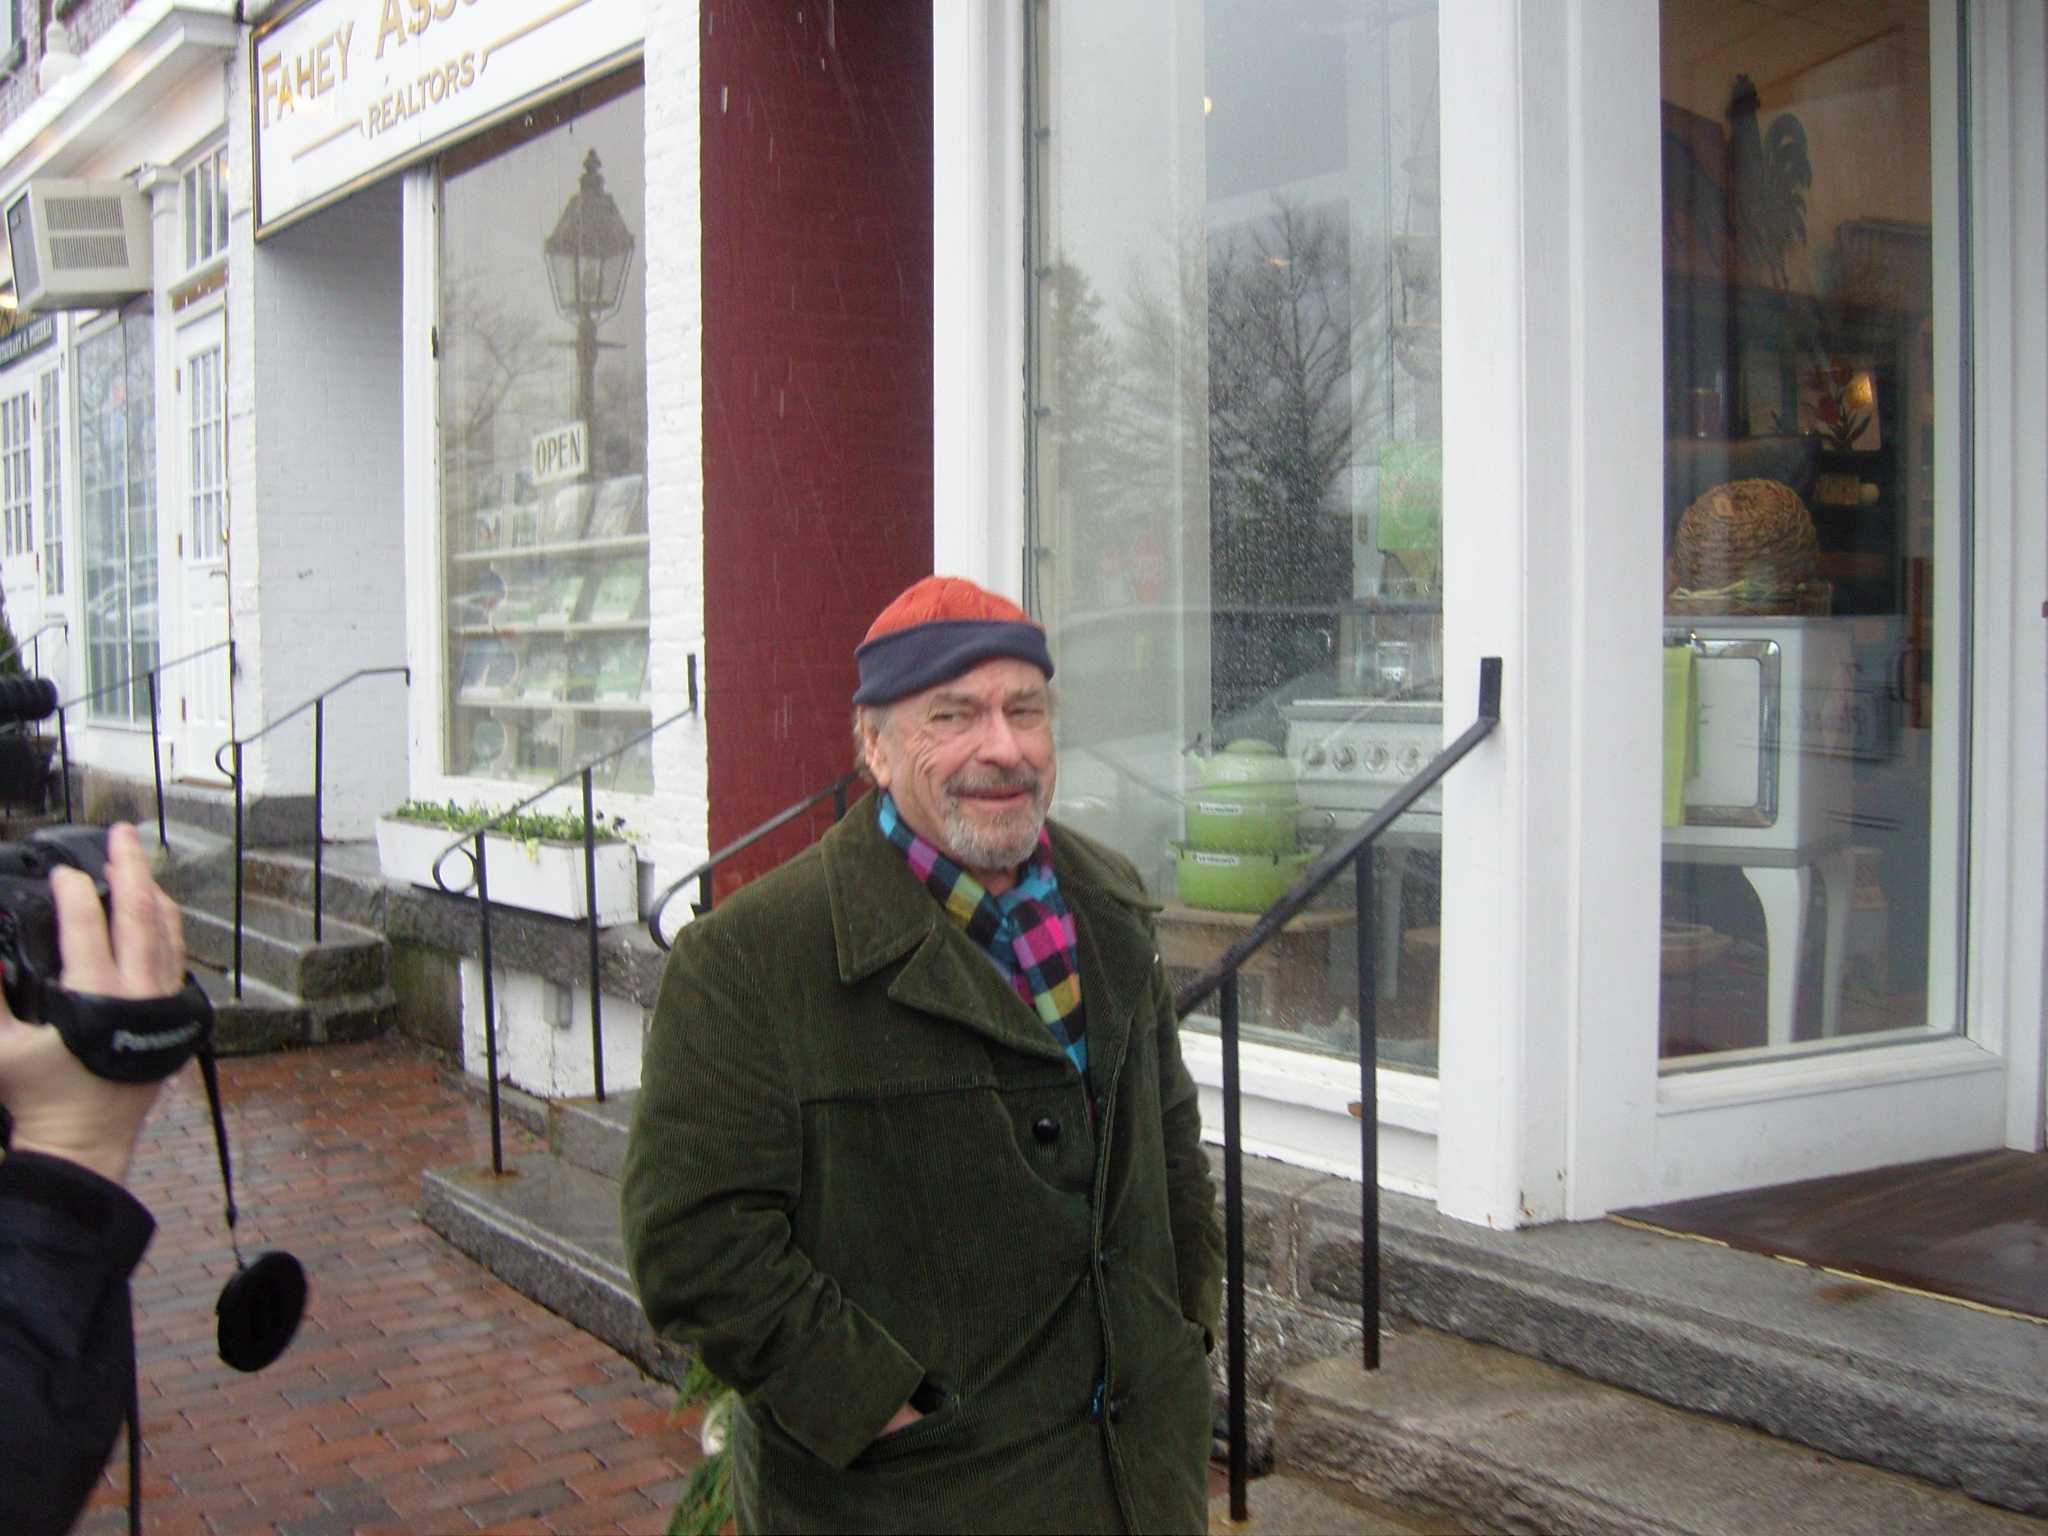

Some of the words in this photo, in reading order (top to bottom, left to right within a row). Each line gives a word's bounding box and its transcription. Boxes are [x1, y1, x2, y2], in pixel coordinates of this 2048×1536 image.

[261, 20, 354, 129] FAHEY
[368, 50, 475, 140] REALTORS
[536, 429, 580, 474] OPEN
